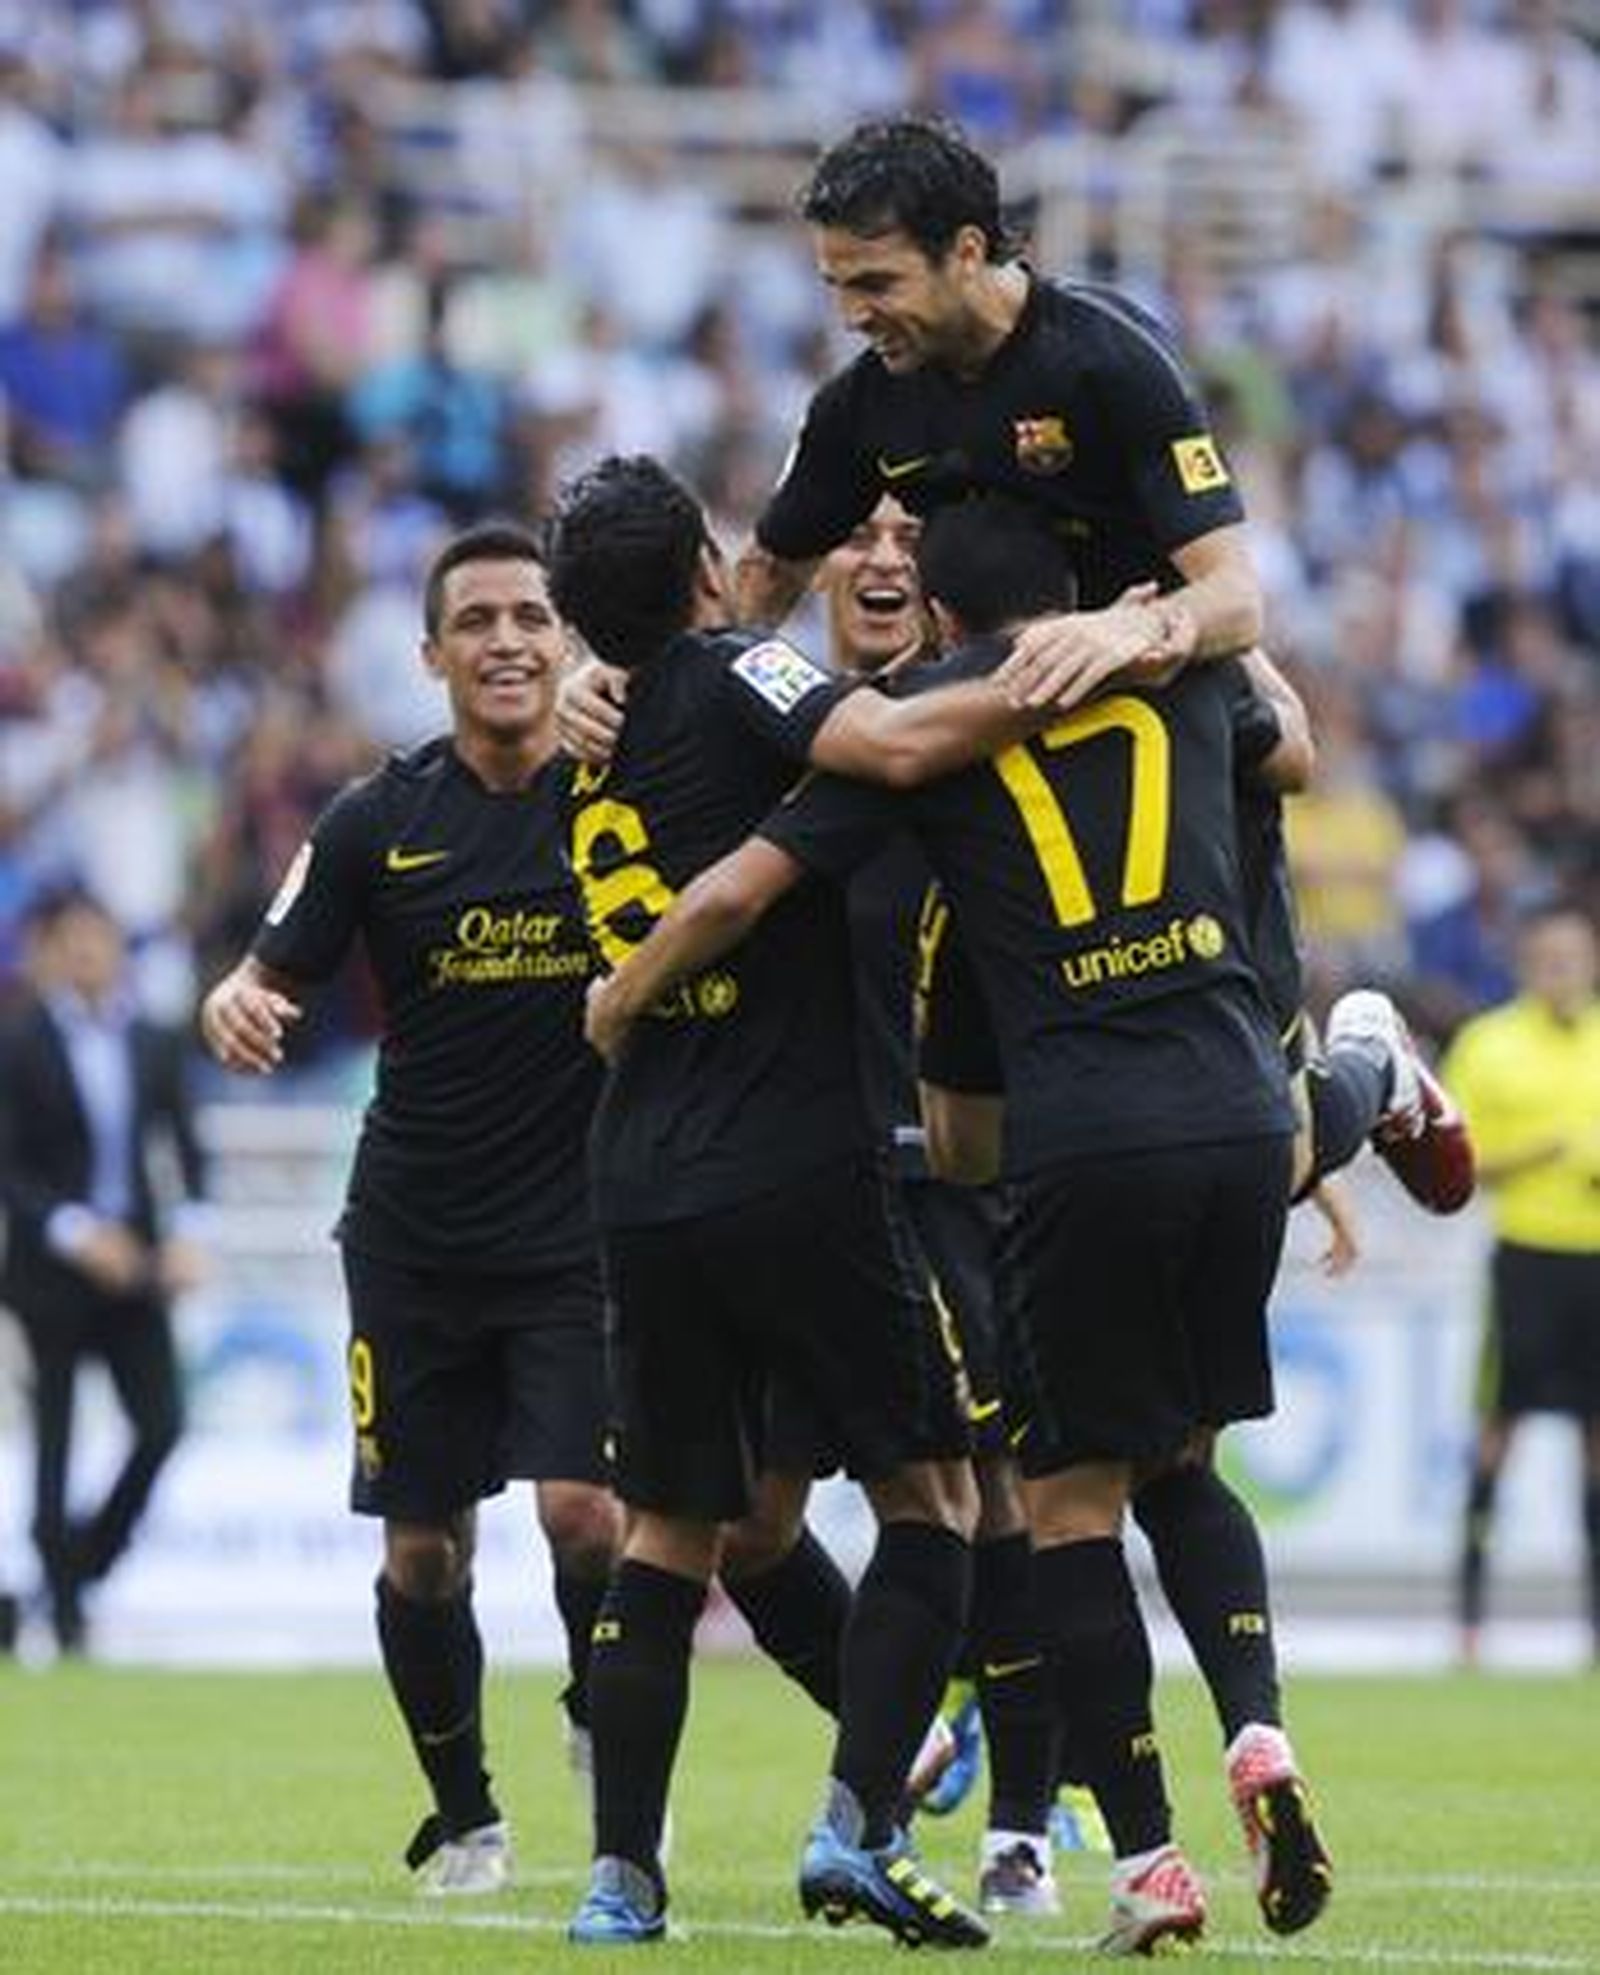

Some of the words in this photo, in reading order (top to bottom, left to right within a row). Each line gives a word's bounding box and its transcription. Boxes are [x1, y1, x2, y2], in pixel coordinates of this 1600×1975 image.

[998, 695, 1169, 927] 17
[457, 907, 561, 949] Qatar
[573, 799, 673, 966] 6
[1062, 919, 1186, 987] unicef
